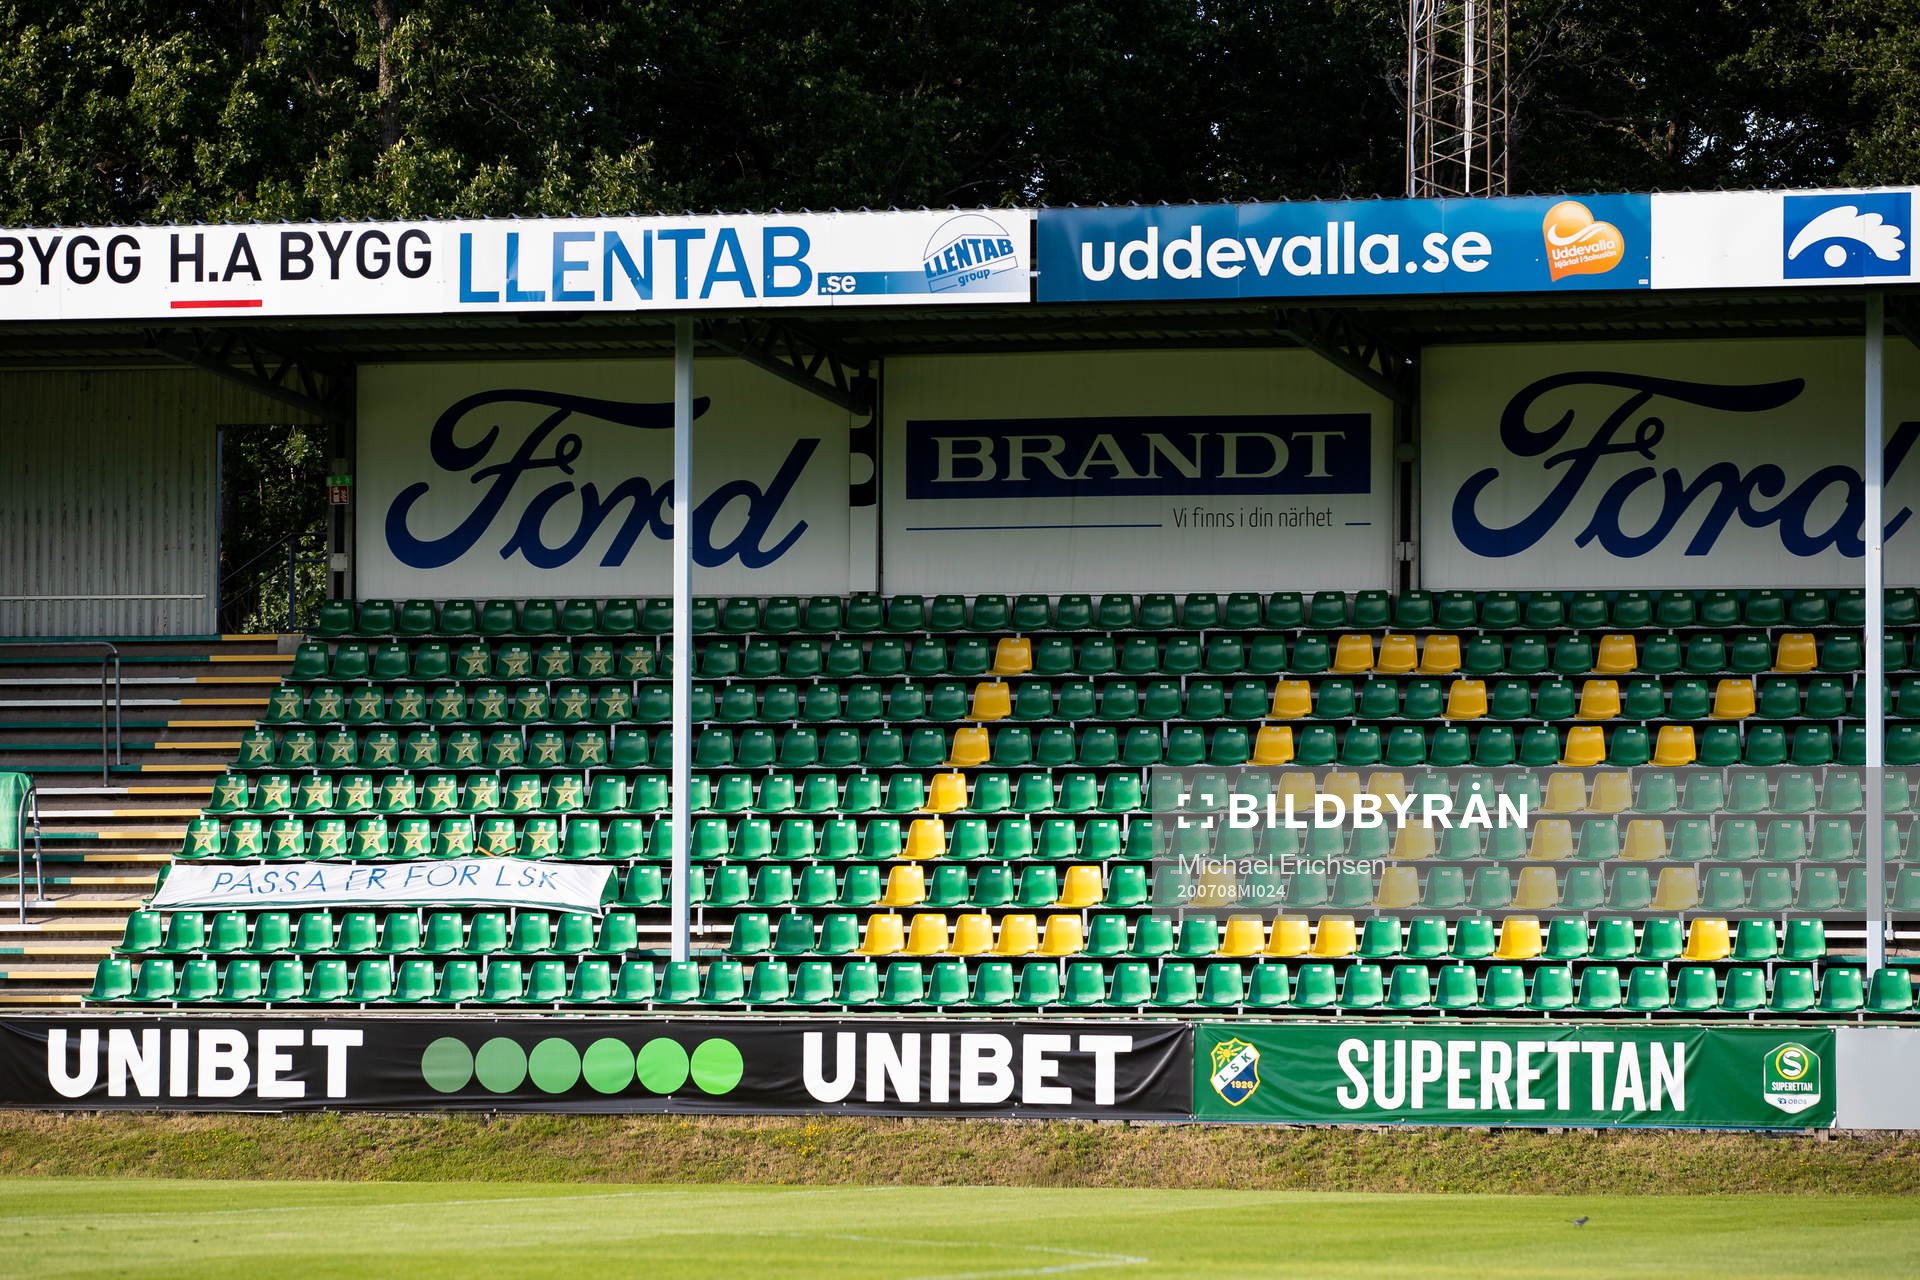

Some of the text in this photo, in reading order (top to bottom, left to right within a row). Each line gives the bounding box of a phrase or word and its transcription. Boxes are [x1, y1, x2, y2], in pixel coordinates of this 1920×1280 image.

[0, 233, 141, 286] BYGG
[279, 229, 432, 281] BYGG
[924, 238, 1015, 279] LLENTAB
[1081, 221, 1492, 282] uddevalla.se
[1551, 239, 1616, 260] Uddevalla
[958, 268, 990, 287] group
[384, 388, 822, 569] Ford
[930, 431, 1346, 483] BRANDT
[1451, 370, 1920, 558] Ford
[1173, 507, 1187, 528] Vi
[1192, 507, 1235, 528] finns
[1249, 507, 1273, 528] din
[1278, 506, 1333, 528] närhet
[211, 870, 327, 894] PASSA
[495, 865, 557, 890] LSK
[47, 1028, 364, 1098] UNIBET
[803, 1032, 1133, 1106] UNIBET
[1219, 1052, 1252, 1083] LSK
[1336, 1038, 1686, 1111] SUPERETTAN
[1771, 1081, 1813, 1092] SUPERETTAN
